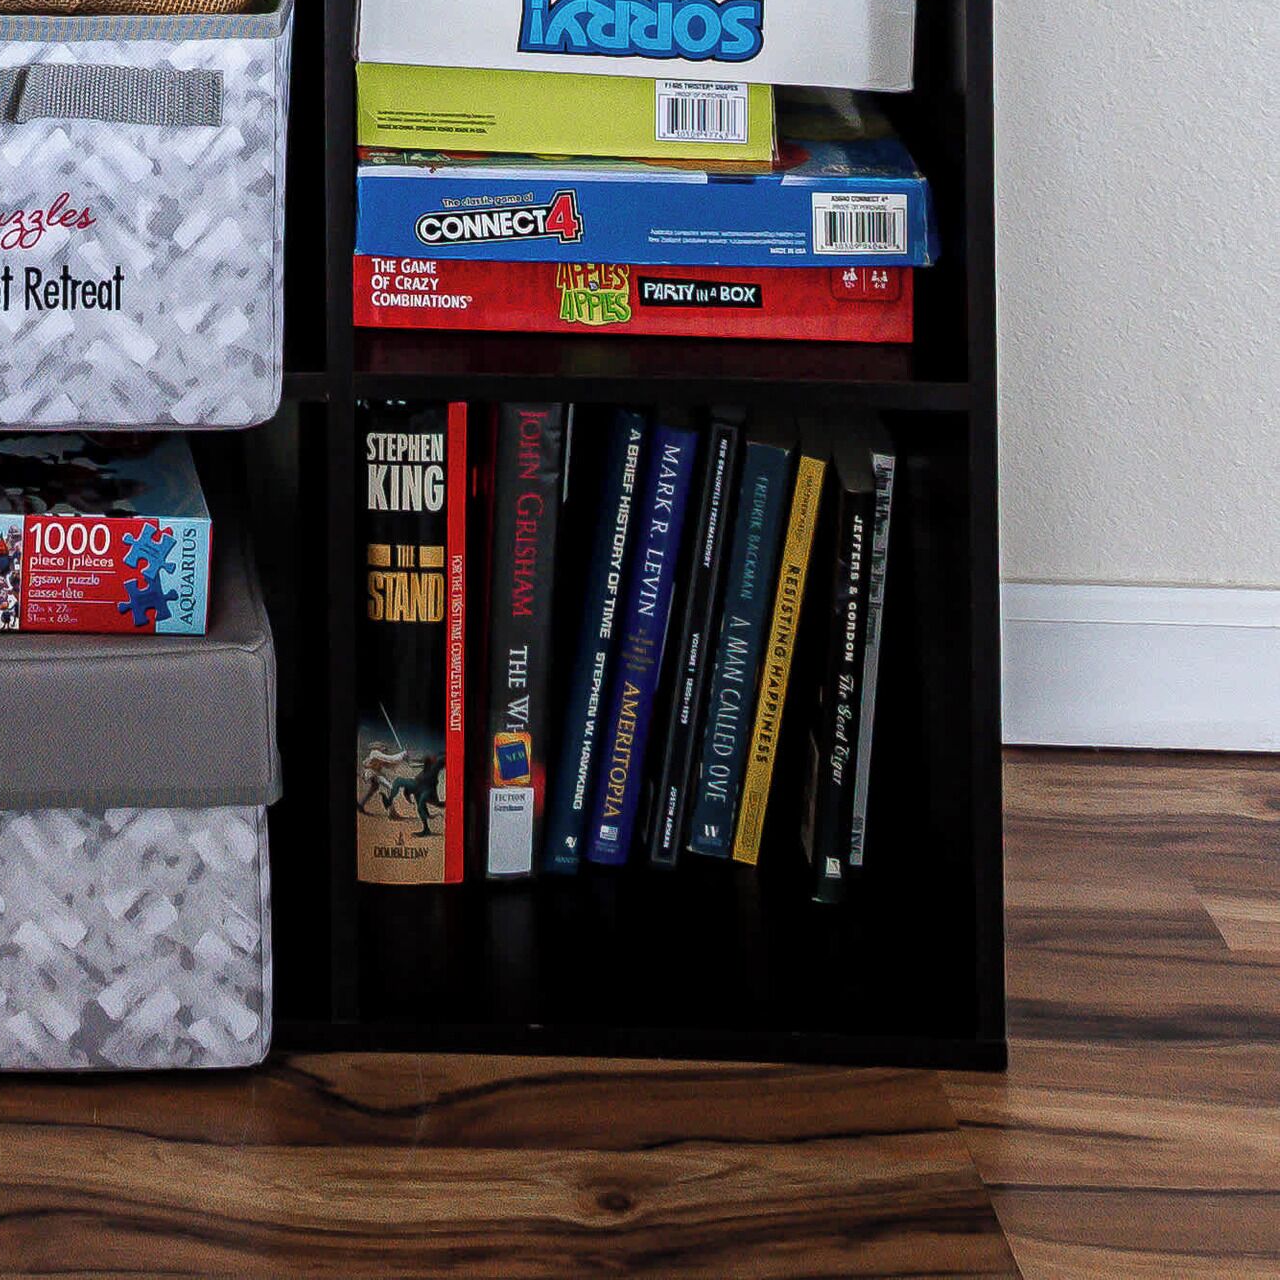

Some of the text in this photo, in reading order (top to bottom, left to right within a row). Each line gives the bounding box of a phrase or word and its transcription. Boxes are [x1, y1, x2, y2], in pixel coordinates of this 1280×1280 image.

[420, 193, 579, 241] CONNECT 4
[441, 192, 534, 207] The classic game of
[24, 266, 125, 311] Retreat
[394, 275, 440, 291] CRAZY
[556, 263, 630, 290] APPLES
[643, 282, 756, 303] PARTY IN A BOX
[560, 290, 632, 323] APPLES
[366, 432, 444, 462] STEPHEN
[367, 465, 445, 512] KING
[511, 410, 549, 617] JOHN GRISHAM
[637, 443, 681, 617] MARK R. LEVIN
[29, 522, 111, 555] 1000
[599, 427, 643, 639] A BRIEF HISTORY OF TIME
[740, 474, 769, 601] FREDRIK BACKMAN
[29, 553, 114, 571] piece pièces
[396, 544, 416, 568] THE
[450, 555, 463, 574] FOR
[28, 573, 100, 587] jigsaw puzzle
[28, 588, 84, 599] casse-tête
[179, 528, 198, 626] AQUARIUS
[450, 574, 463, 592] THE
[845, 514, 864, 663] JEFFERS & GORDON
[367, 571, 445, 623] STAND
[450, 618, 463, 640] TIME
[450, 642, 462, 690] COMPLETE
[507, 645, 528, 689] THE
[756, 564, 801, 764] RESISTING HAPPINESS
[836, 673, 855, 701] The
[705, 615, 752, 803] A MAN CALLED OVE
[834, 703, 853, 743] Good
[572, 651, 606, 810] STEPHEN W. HAWKING
[603, 680, 641, 818] AMERITOPIA
[494, 793, 526, 802] FICTION
[373, 846, 429, 859] DOUBLEDAY
